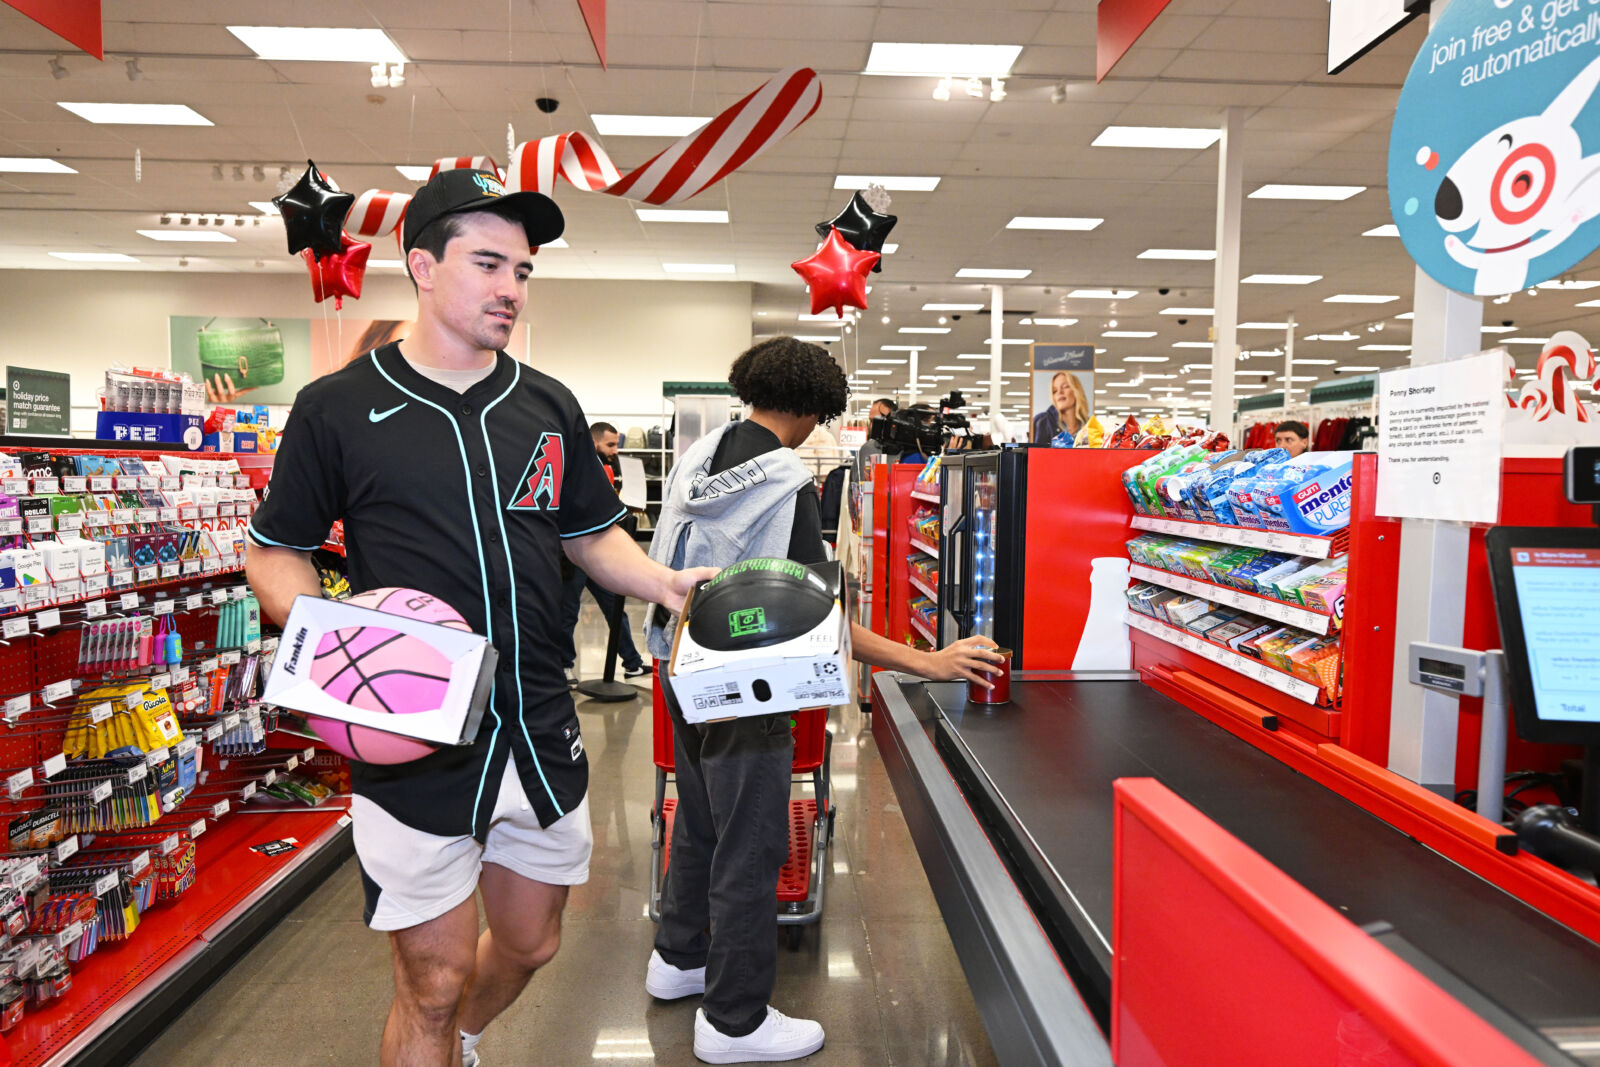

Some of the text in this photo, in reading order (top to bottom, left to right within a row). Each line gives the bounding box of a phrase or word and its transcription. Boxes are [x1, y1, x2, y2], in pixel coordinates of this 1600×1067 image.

[1429, 0, 1581, 74] join free & get
[13, 390, 50, 403] holiday price
[1389, 386, 1436, 397] Penny Shortage
[13, 402, 61, 412] match guarantee
[188, 416, 200, 426] PEZ
[113, 425, 158, 441] PEZ
[1300, 474, 1353, 516] mento
[24, 507, 47, 516] ROBLOX
[1313, 494, 1352, 526] PURE
[1262, 519, 1290, 529] mentos
[17, 560, 42, 570] Google Play
[283, 626, 309, 676] franklin
[143, 696, 167, 711] Ricola
[1560, 703, 1586, 713] Total
[32, 810, 60, 828] DURACELL
[175, 842, 196, 875] UNO
